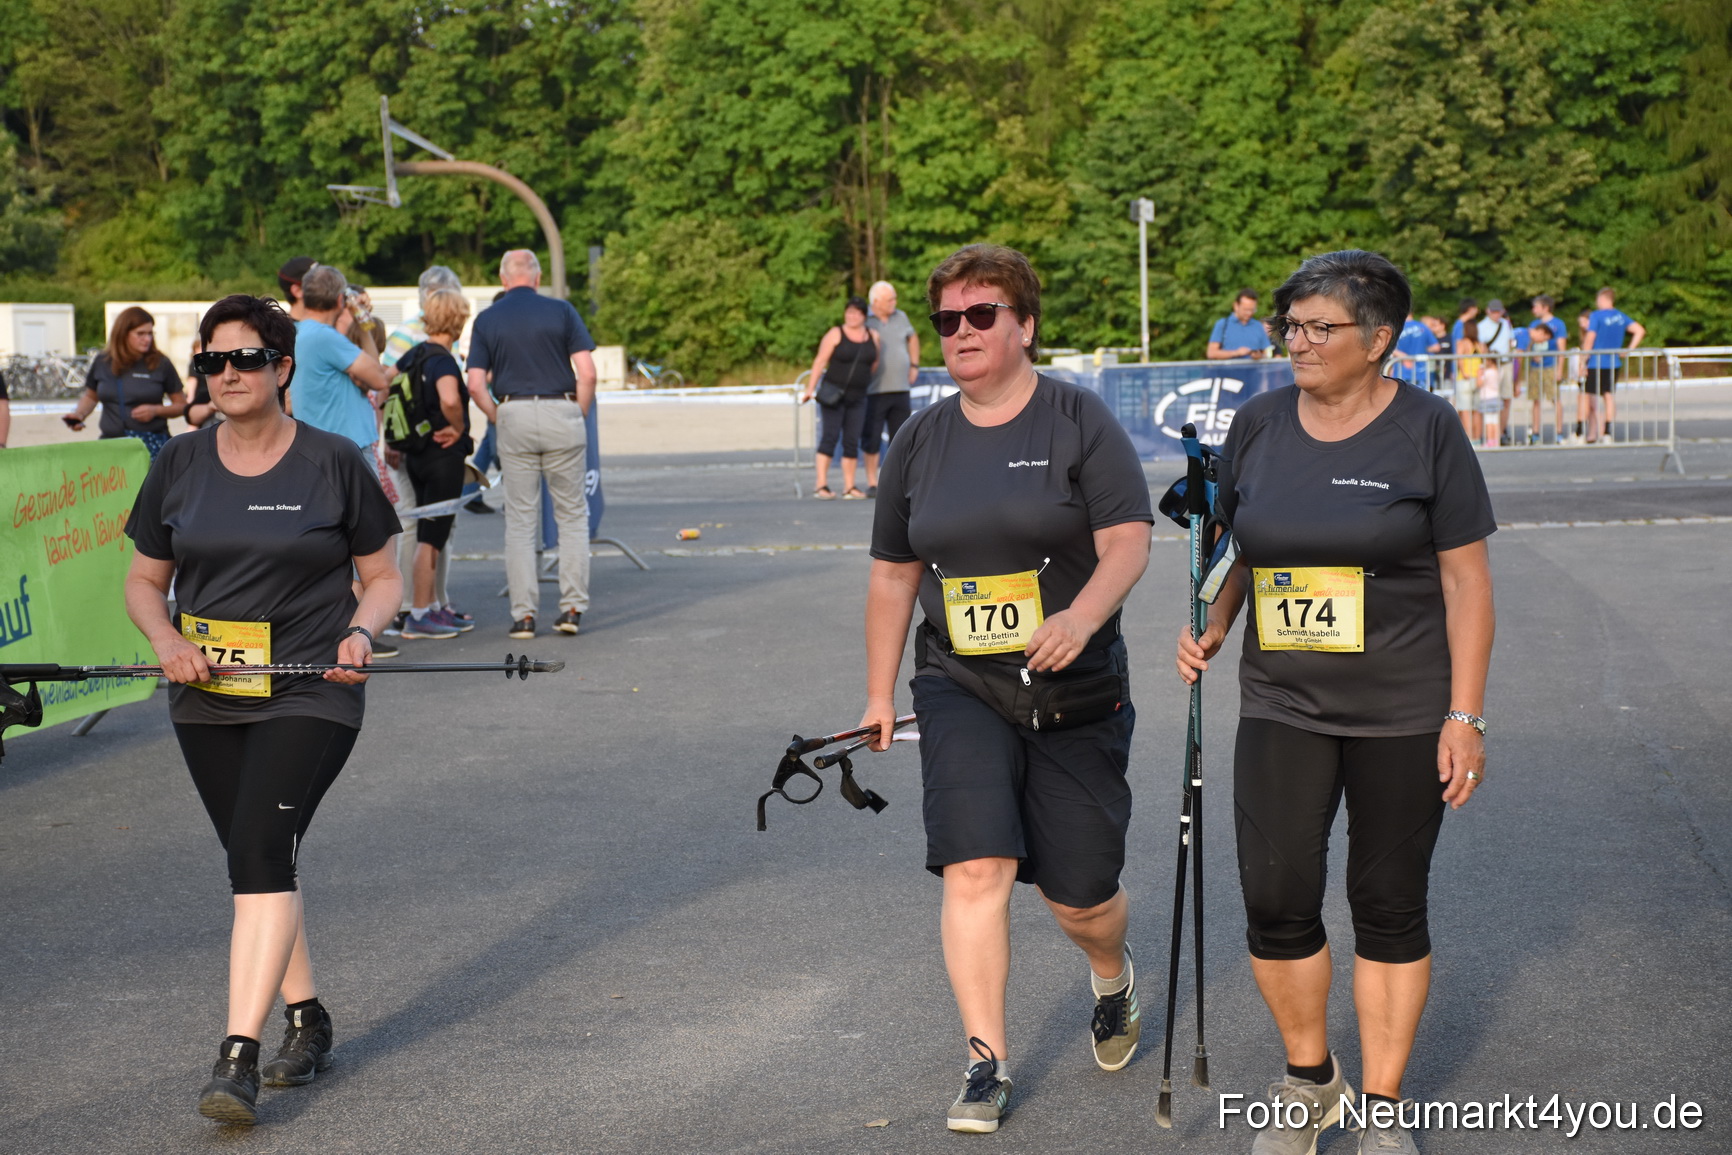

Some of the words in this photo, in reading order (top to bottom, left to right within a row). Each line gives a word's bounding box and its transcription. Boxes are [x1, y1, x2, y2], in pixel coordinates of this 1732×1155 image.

[1008, 460, 1030, 469] Bettina
[1031, 459, 1049, 468] Pretzl
[1331, 478, 1358, 486] Isabella
[1360, 479, 1390, 490] Schmidt
[13, 471, 78, 529] Gesunde
[79, 465, 128, 503] Firmen
[275, 504, 302, 512] Schmidt
[43, 518, 93, 566] laufen
[1268, 583, 1309, 593] firmenlauf
[964, 602, 1019, 633] 170
[1277, 598, 1337, 628] 174
[991, 631, 1020, 640] Bettina
[1276, 629, 1308, 637] Schmidt
[1309, 630, 1341, 638] Isabella
[221, 675, 252, 684] Johanna
